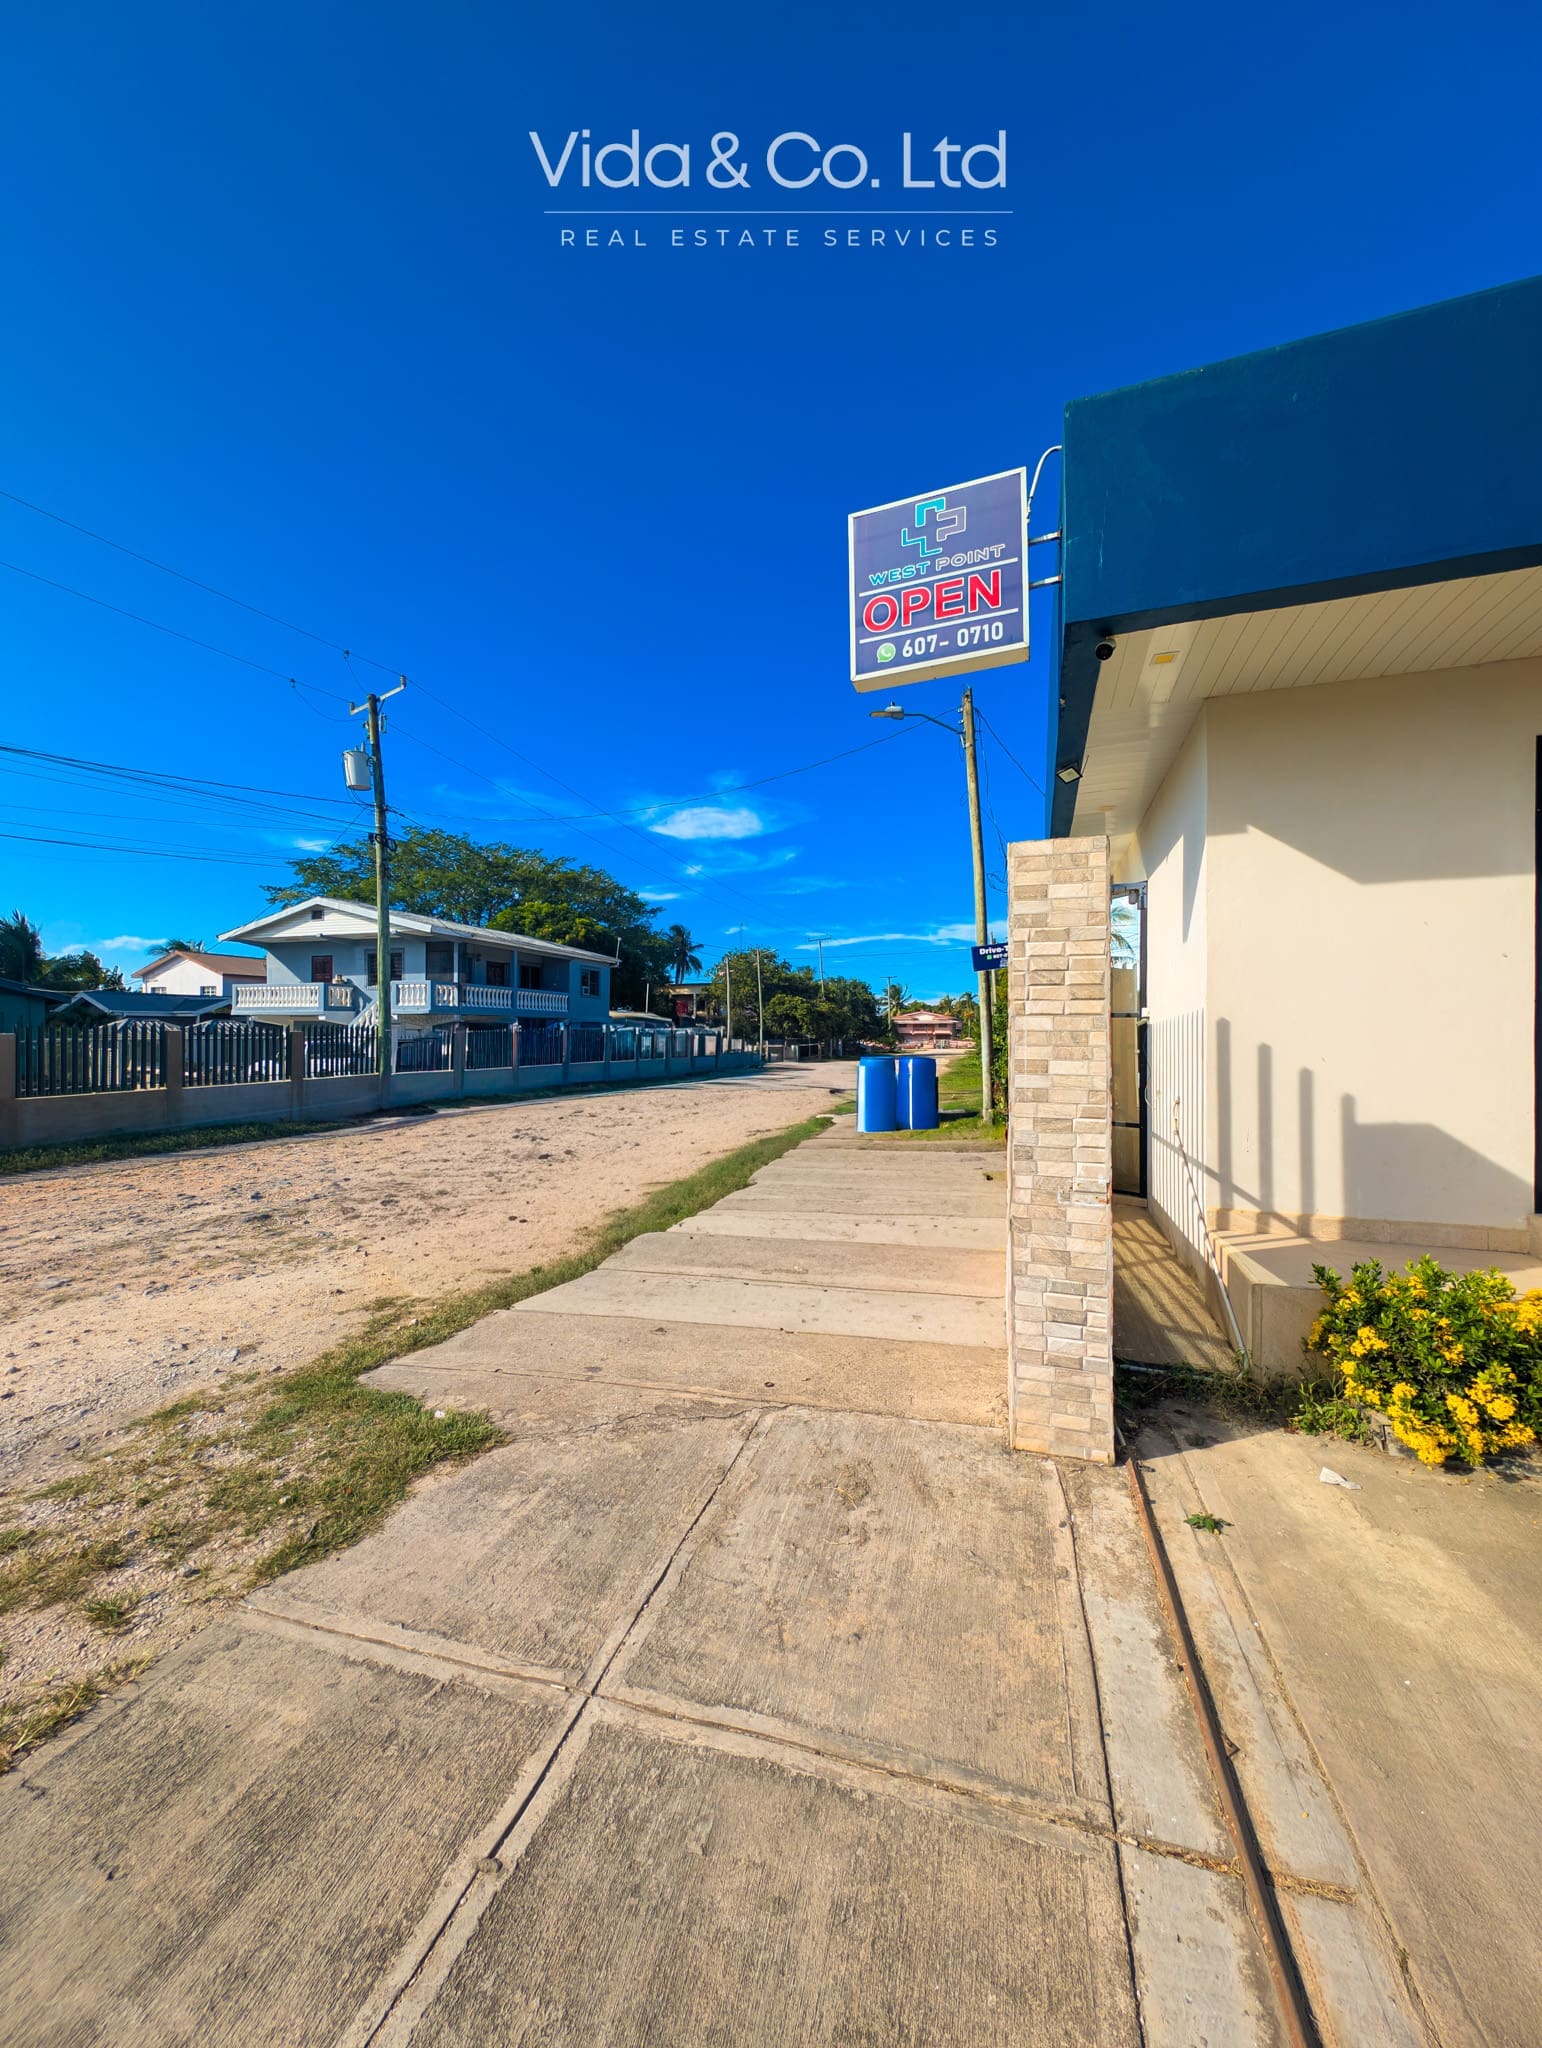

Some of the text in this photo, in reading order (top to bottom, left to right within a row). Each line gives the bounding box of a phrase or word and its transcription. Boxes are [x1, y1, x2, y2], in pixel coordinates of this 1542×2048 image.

[868, 544, 1006, 586] WEST POINT
[863, 569, 1002, 633] OPEN
[902, 621, 1004, 658] 607- 0710
